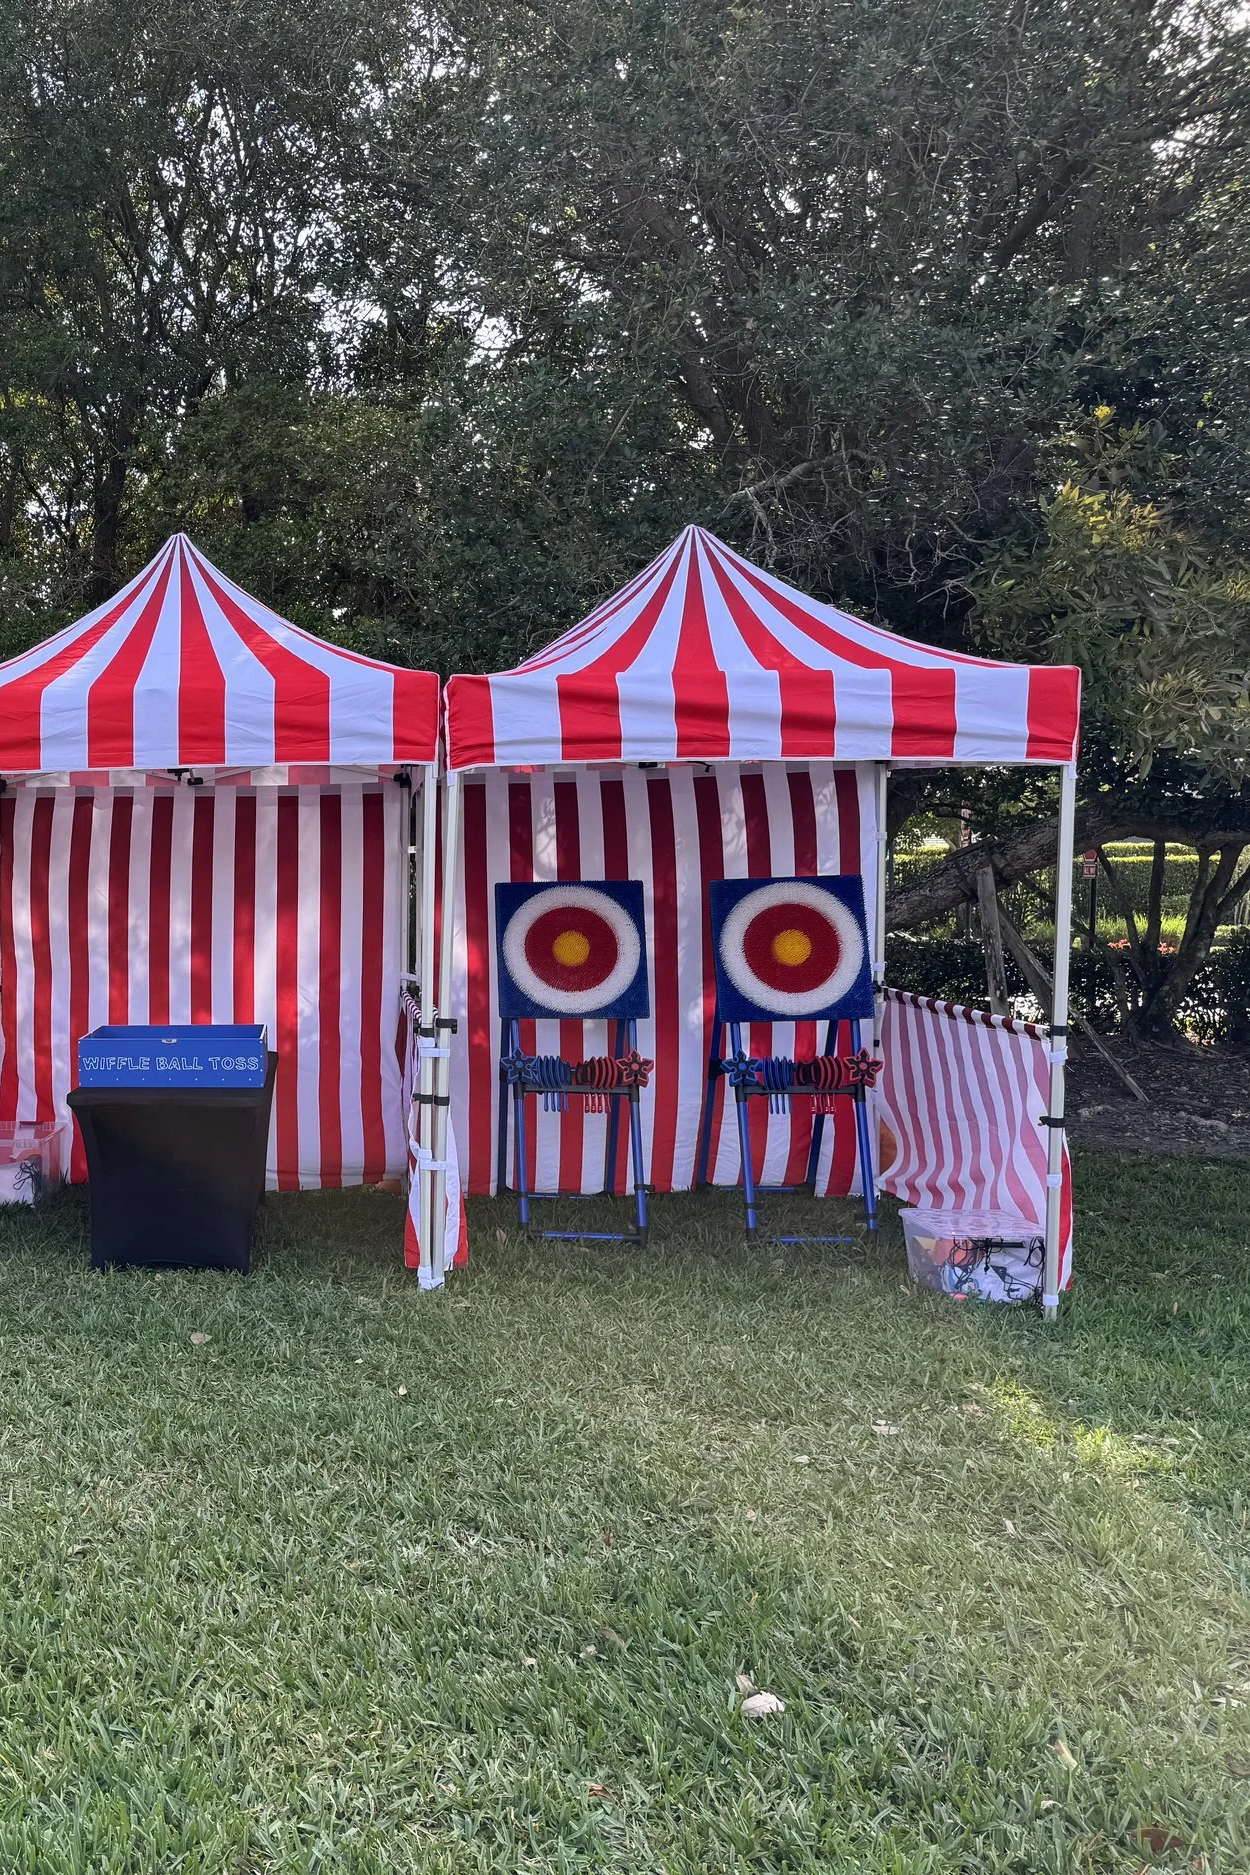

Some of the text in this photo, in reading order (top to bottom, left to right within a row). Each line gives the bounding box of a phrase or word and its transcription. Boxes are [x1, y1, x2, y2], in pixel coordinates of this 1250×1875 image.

[82, 1057, 259, 1071] WIFFLE BALL TOSS
